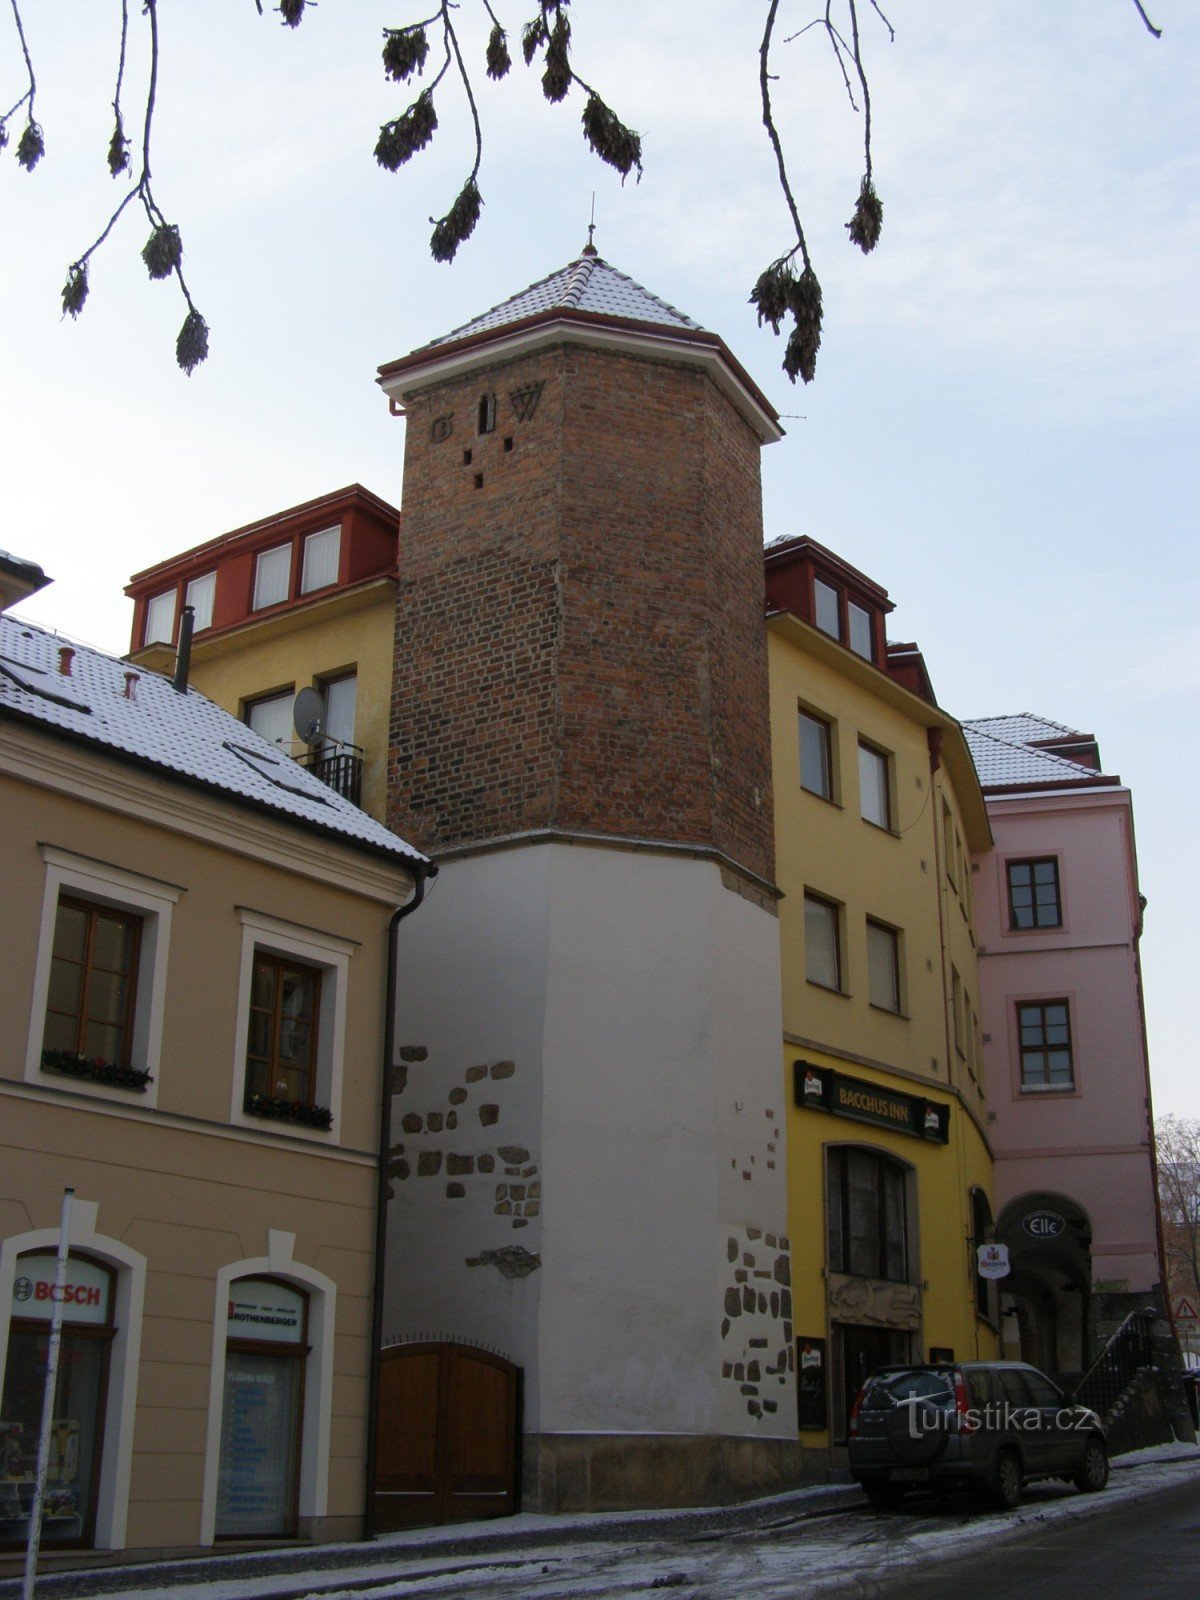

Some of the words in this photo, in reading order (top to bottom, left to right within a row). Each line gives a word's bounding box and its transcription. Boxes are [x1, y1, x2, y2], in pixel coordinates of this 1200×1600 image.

[839, 1087, 889, 1117] BACCHUS
[889, 1105, 909, 1122] INN
[1030, 1218, 1057, 1234] Elle
[234, 1312, 298, 1326] ROTHENBERGER
